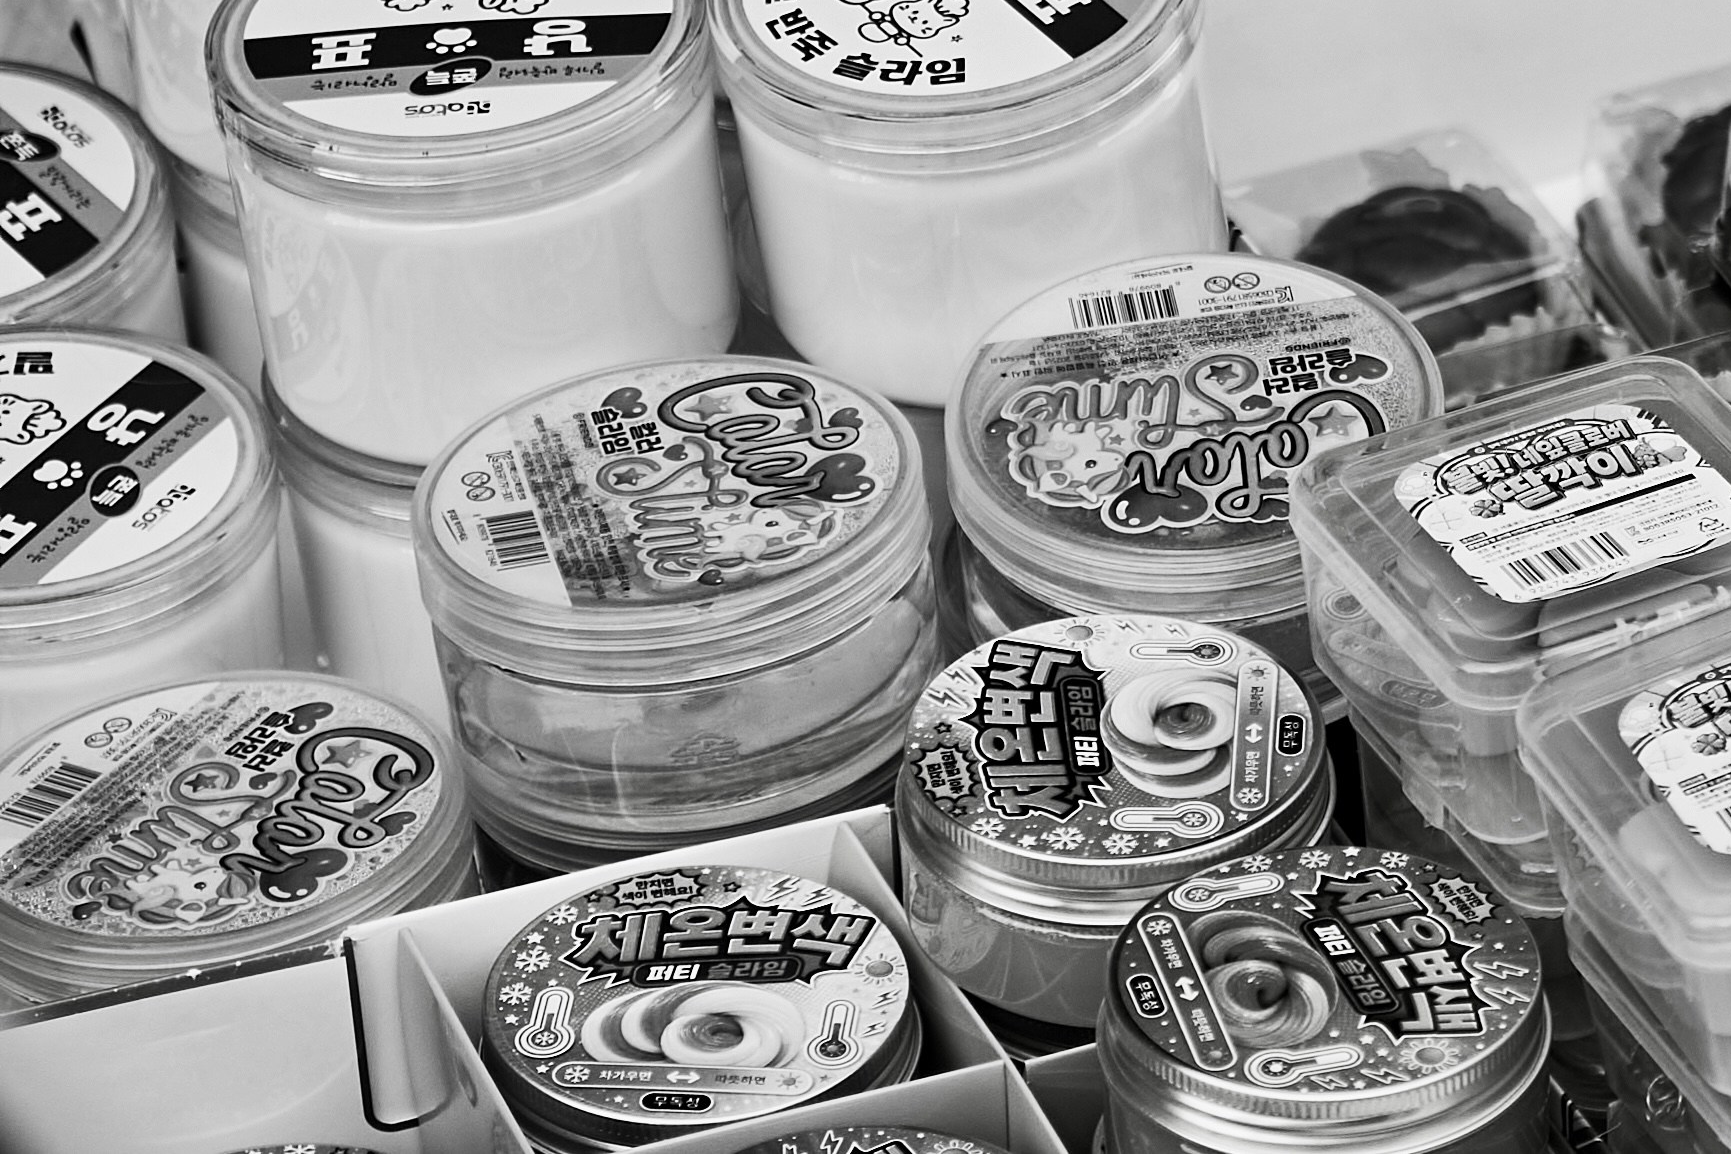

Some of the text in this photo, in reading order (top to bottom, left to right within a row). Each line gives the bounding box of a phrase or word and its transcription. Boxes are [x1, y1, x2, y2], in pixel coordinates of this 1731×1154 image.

[309, 18, 594, 71] 냥 표
[766, 6, 840, 64] 반죽
[831, 52, 967, 86] 슬라임
[423, 66, 482, 88] 쫀득
[1263, 372, 1318, 396] 컬러
[1267, 348, 1355, 376] 슬라임
[87, 403, 165, 446] 냥
[590, 406, 633, 457] 슬라임
[627, 419, 666, 456] 컬러
[91, 474, 138, 507] 쫀득
[1489, 443, 1639, 510] 딸깍이
[224, 710, 295, 760] 슬라임
[974, 640, 1084, 818] 체온변색
[1066, 684, 1102, 768] 퍼티 슬라임
[242, 738, 295, 772] 컬러
[571, 904, 876, 966] 체온변색
[1320, 872, 1490, 1036] 체온변색
[645, 957, 788, 982] 퍼티 슬라임
[1314, 924, 1388, 1011] 퍼티 슬라임
[598, 1068, 767, 1087] 차가우면 따뜻하면
[653, 1093, 701, 1110] 무독성
